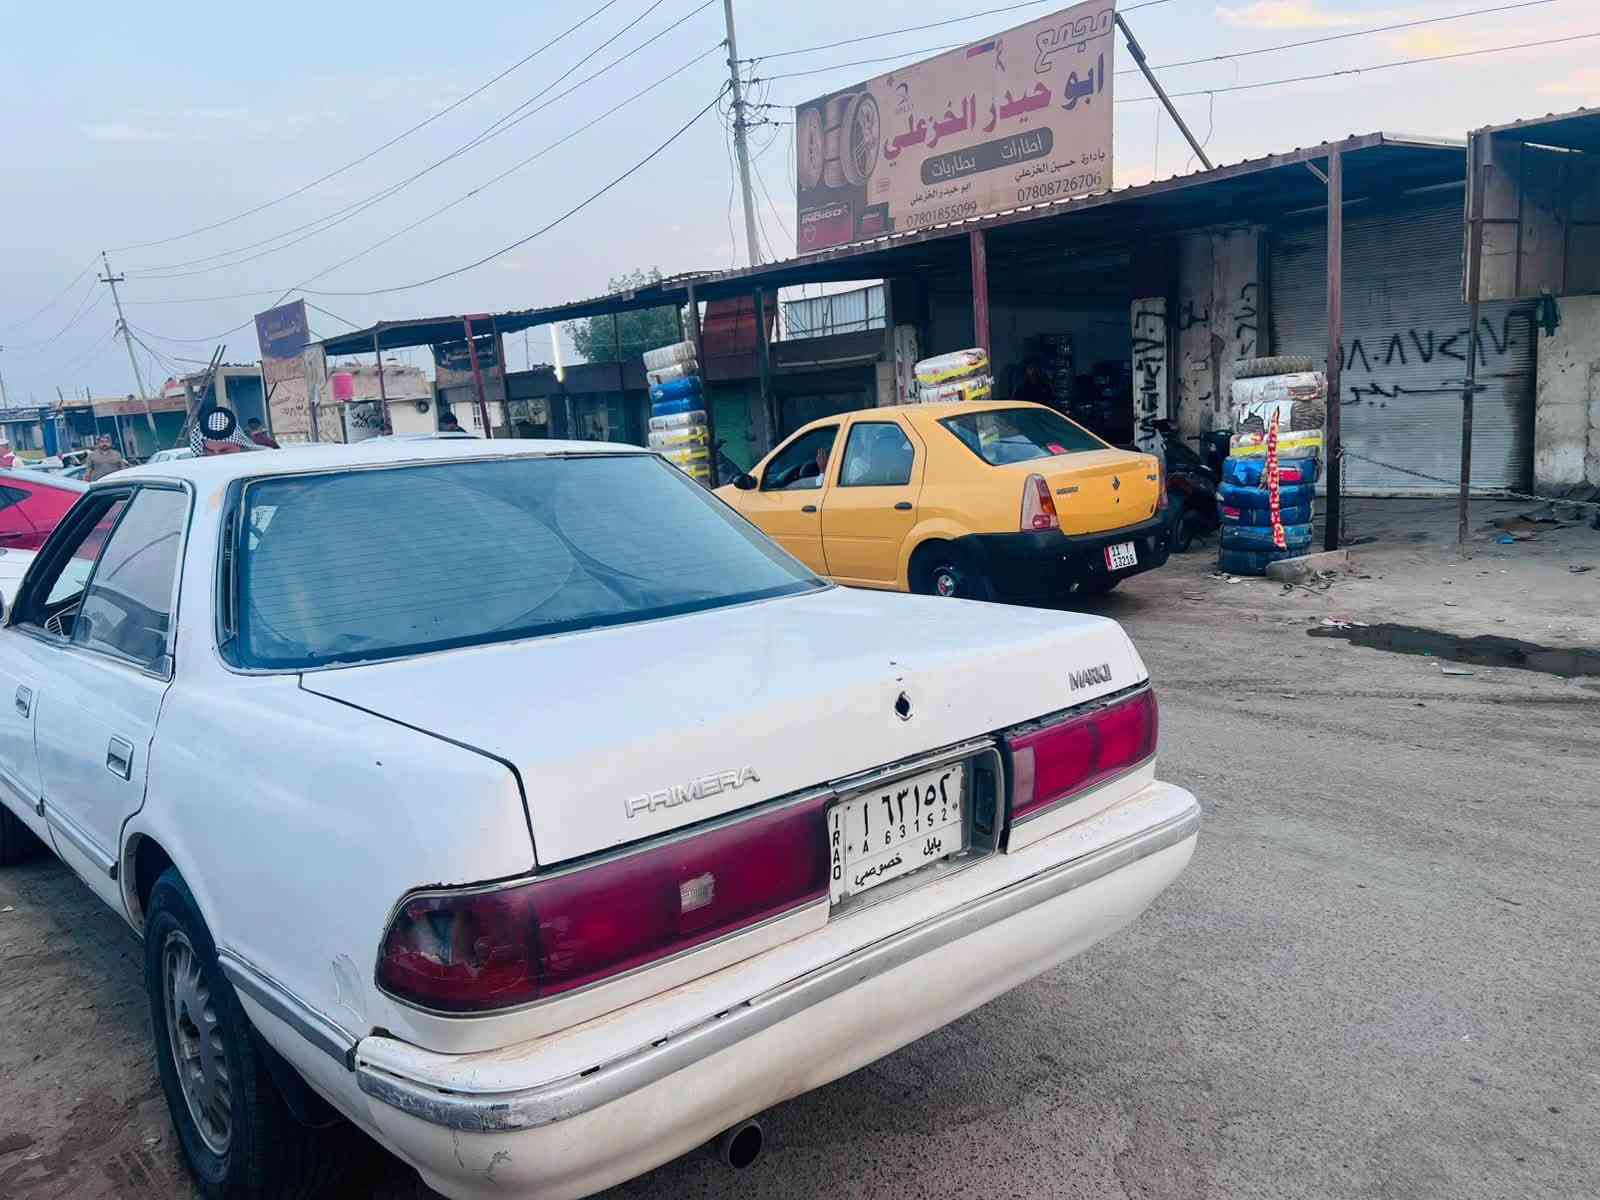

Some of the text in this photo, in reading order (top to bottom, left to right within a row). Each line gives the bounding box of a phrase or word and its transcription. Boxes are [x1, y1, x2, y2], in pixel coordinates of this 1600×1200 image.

[983, 80, 1051, 132] حيدر
[884, 93, 976, 167] الخزعلي
[885, 808, 948, 845] 63152
[922, 837, 942, 856] بابل
[854, 852, 903, 887] خصوصي
